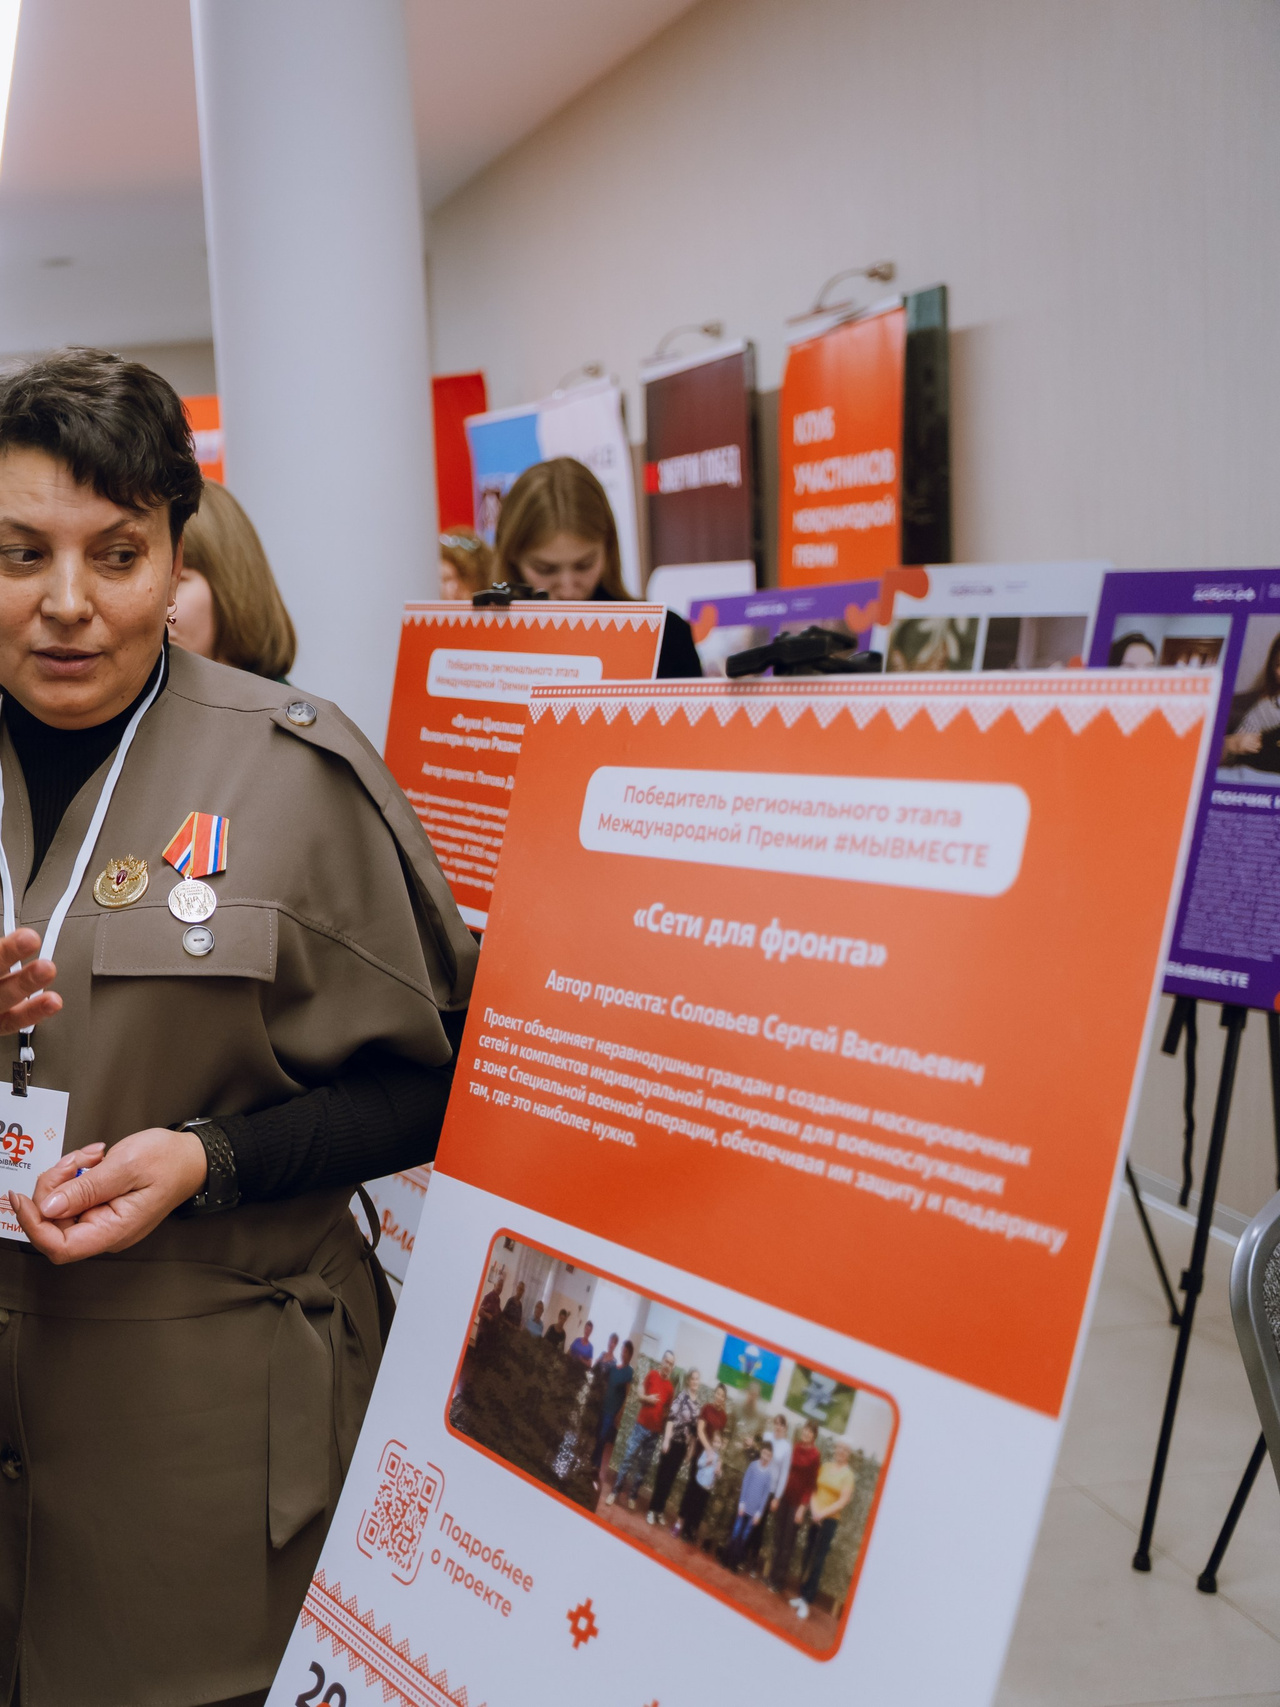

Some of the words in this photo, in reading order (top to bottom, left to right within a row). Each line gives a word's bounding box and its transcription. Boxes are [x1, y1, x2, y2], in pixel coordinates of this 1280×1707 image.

[597, 813, 741, 843] Международной
[746, 825, 828, 852] Премии
[833, 832, 990, 868] #МЫВМЕСТЕ
[623, 785, 726, 810] Победитель
[731, 795, 890, 823] регионального
[895, 805, 963, 829] этапа
[632, 902, 704, 938] «Сети
[704, 918, 756, 948] для
[760, 917, 888, 967] фронта»
[545, 969, 592, 1002] Автор
[593, 983, 667, 1016] проекта:
[670, 994, 760, 1036] Соловьев
[762, 1013, 839, 1053] Сергей
[840, 1029, 986, 1087] Васильевич
[469, 1080, 490, 1102] там,
[491, 1088, 511, 1107] где
[511, 1095, 532, 1112] это
[532, 1101, 591, 1132] наиболее
[591, 1120, 638, 1148] нужно.
[478, 1034, 509, 1054] сетей
[509, 1043, 518, 1056] и
[519, 1045, 589, 1077] комплектов
[590, 1065, 703, 1109] индивидуальной
[705, 1096, 800, 1136] маскировки
[800, 1124, 835, 1147] для
[836, 1132, 1006, 1196] военнослужащих
[483, 1007, 524, 1031] Проект
[524, 1019, 595, 1050] объединяет
[595, 1039, 706, 1080] неравнодушных
[706, 1067, 772, 1097] граждан
[775, 1084, 786, 1101] в
[787, 1088, 870, 1123] создании
[871, 1108, 1032, 1167] маскировочных
[473, 1058, 481, 1071] в
[481, 1061, 508, 1079] зоне
[508, 1064, 587, 1103] Специальной
[587, 1091, 643, 1121] военной
[644, 1108, 718, 1147] операции,
[720, 1129, 826, 1176] обеспечивая
[827, 1163, 853, 1184] им
[854, 1170, 925, 1212] защиту
[925, 1191, 943, 1212] и
[942, 1196, 1068, 1256] поддержку
[430, 1548, 441, 1566] о
[442, 1555, 513, 1618] проекте
[439, 1511, 534, 1593] Подробнее
